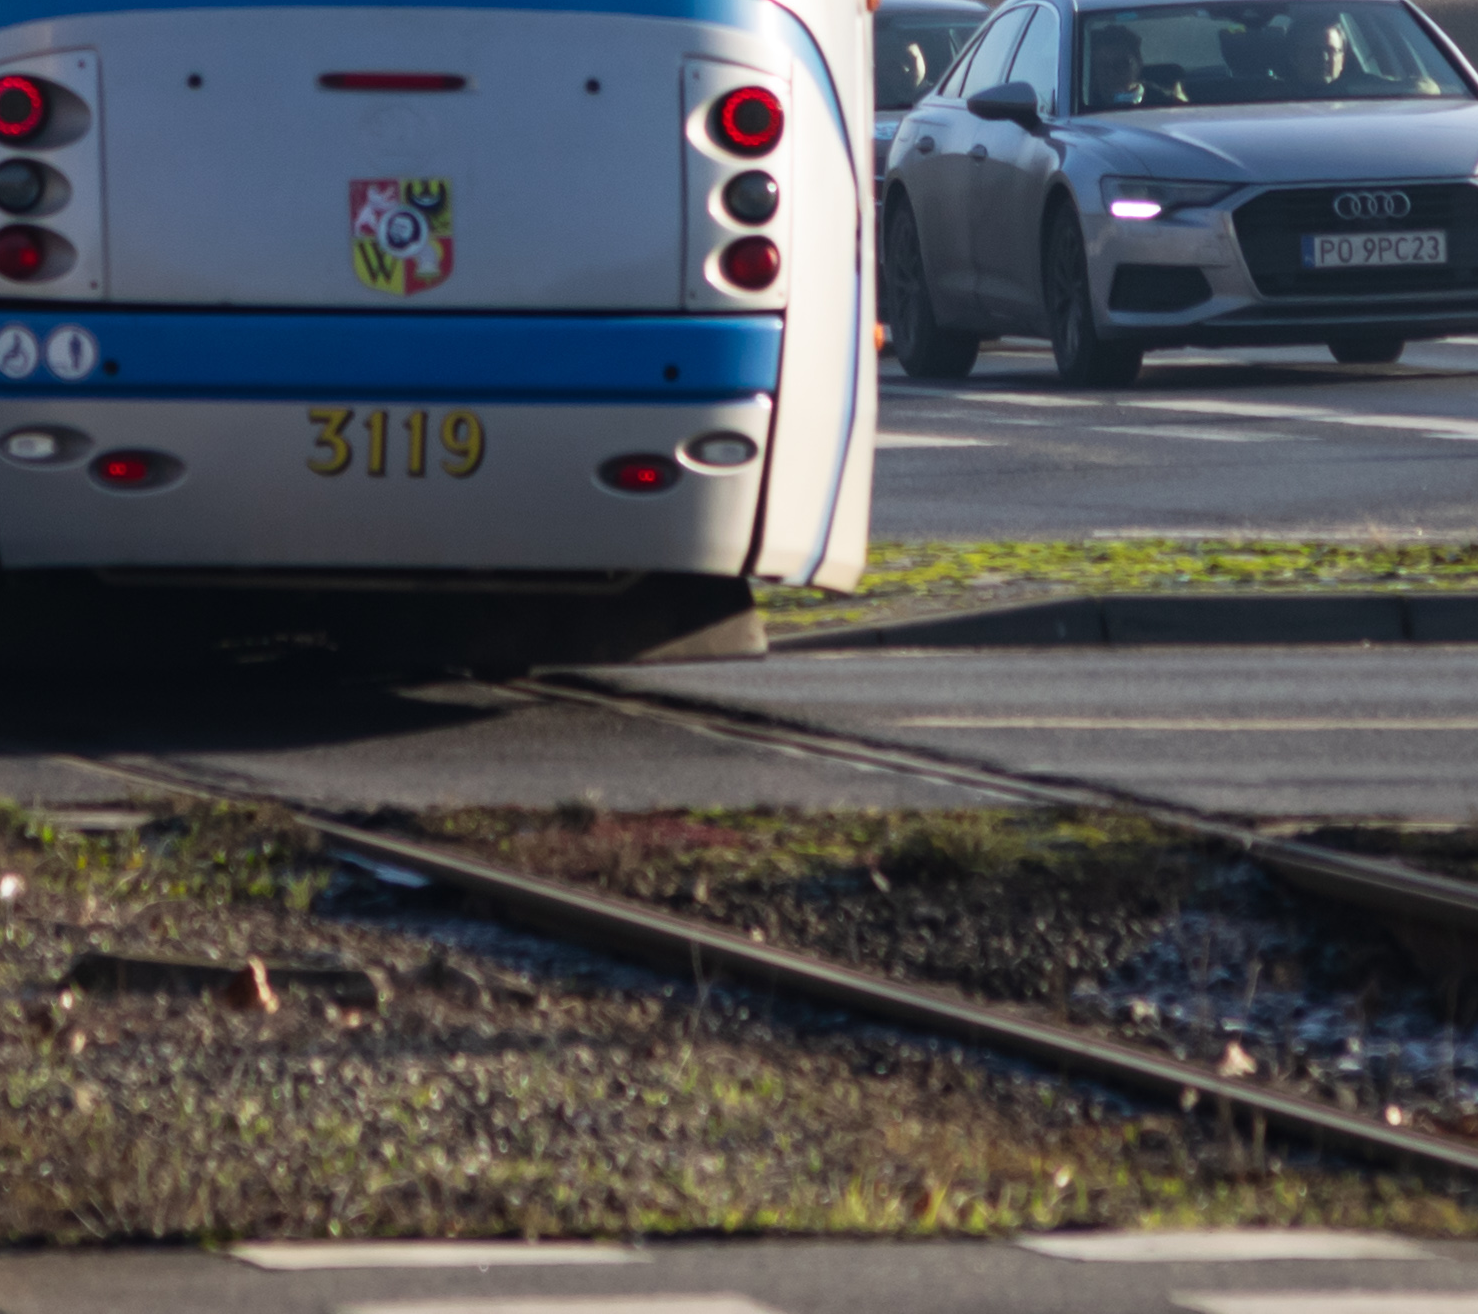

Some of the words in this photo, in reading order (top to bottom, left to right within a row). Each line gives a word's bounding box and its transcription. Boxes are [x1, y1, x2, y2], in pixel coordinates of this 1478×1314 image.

[1319, 238, 1353, 264] PO
[1363, 235, 1441, 262] 9PC23
[307, 407, 486, 479] 3119
